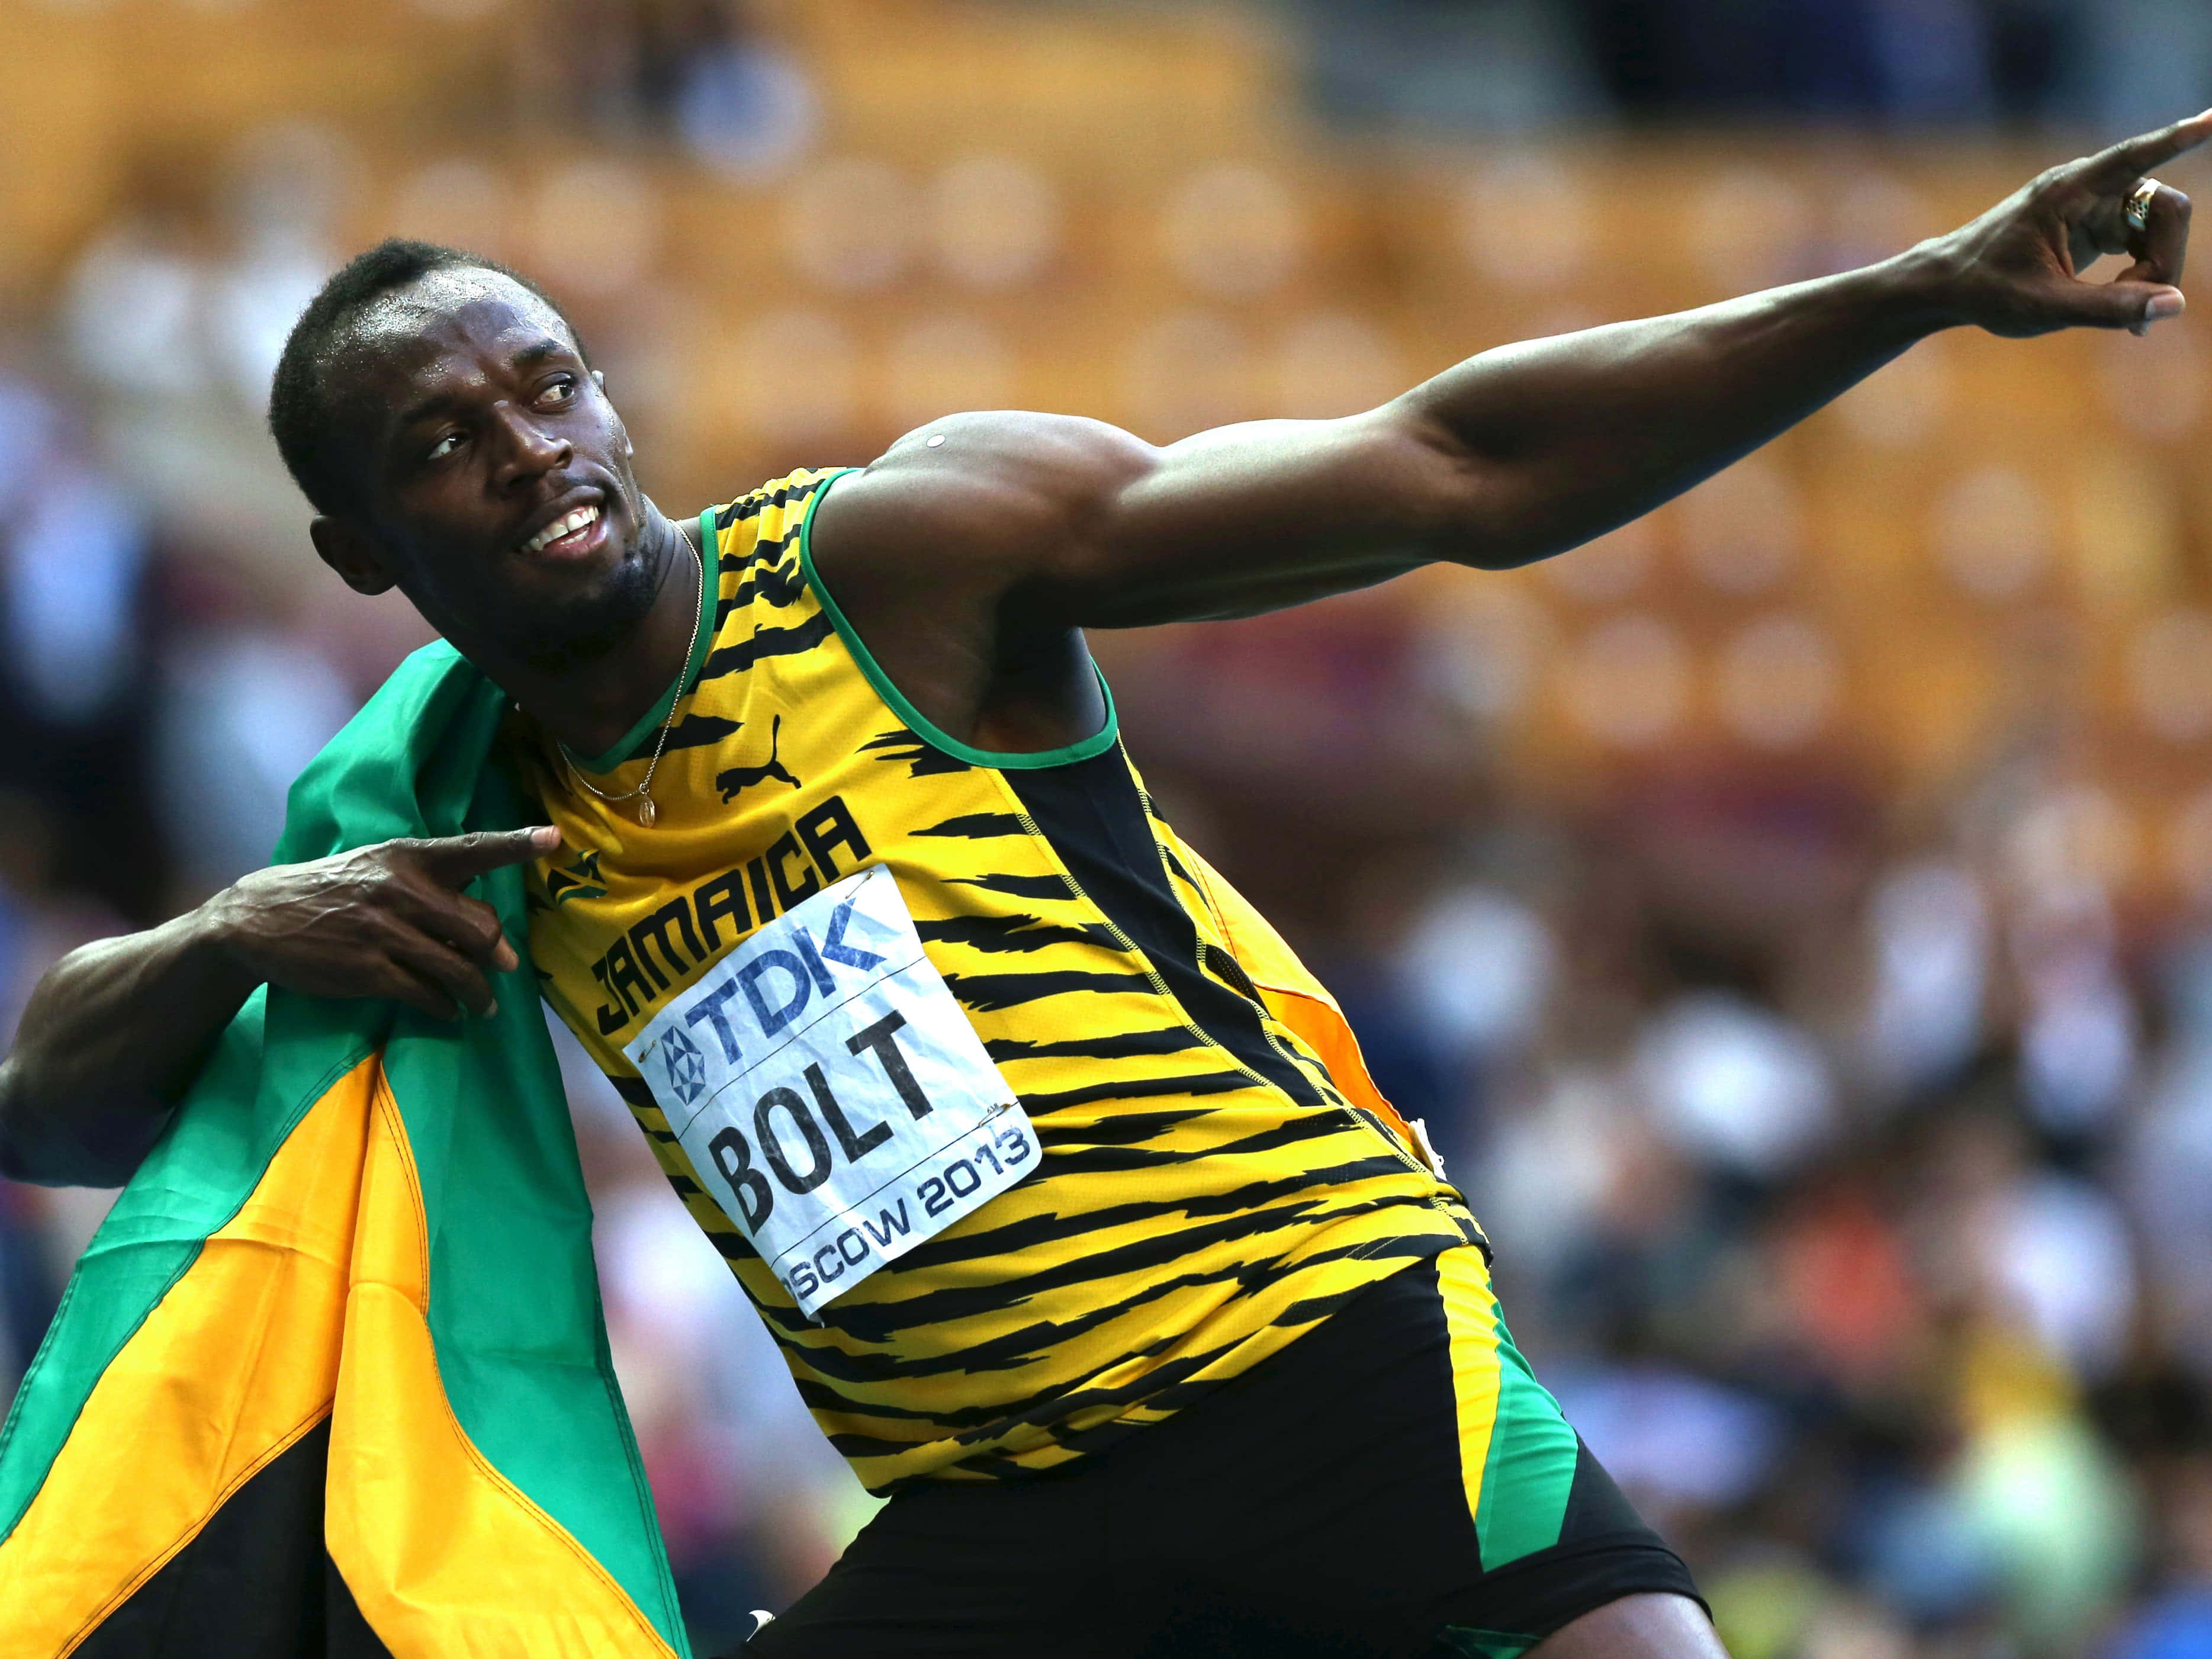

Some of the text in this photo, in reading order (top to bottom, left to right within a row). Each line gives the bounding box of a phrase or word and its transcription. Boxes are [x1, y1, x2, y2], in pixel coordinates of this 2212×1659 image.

[591, 795, 872, 1036] JAMAICA
[685, 897, 888, 1065] TDK
[707, 1008, 934, 1237] BOLT
[917, 1126, 1030, 1218] 2013
